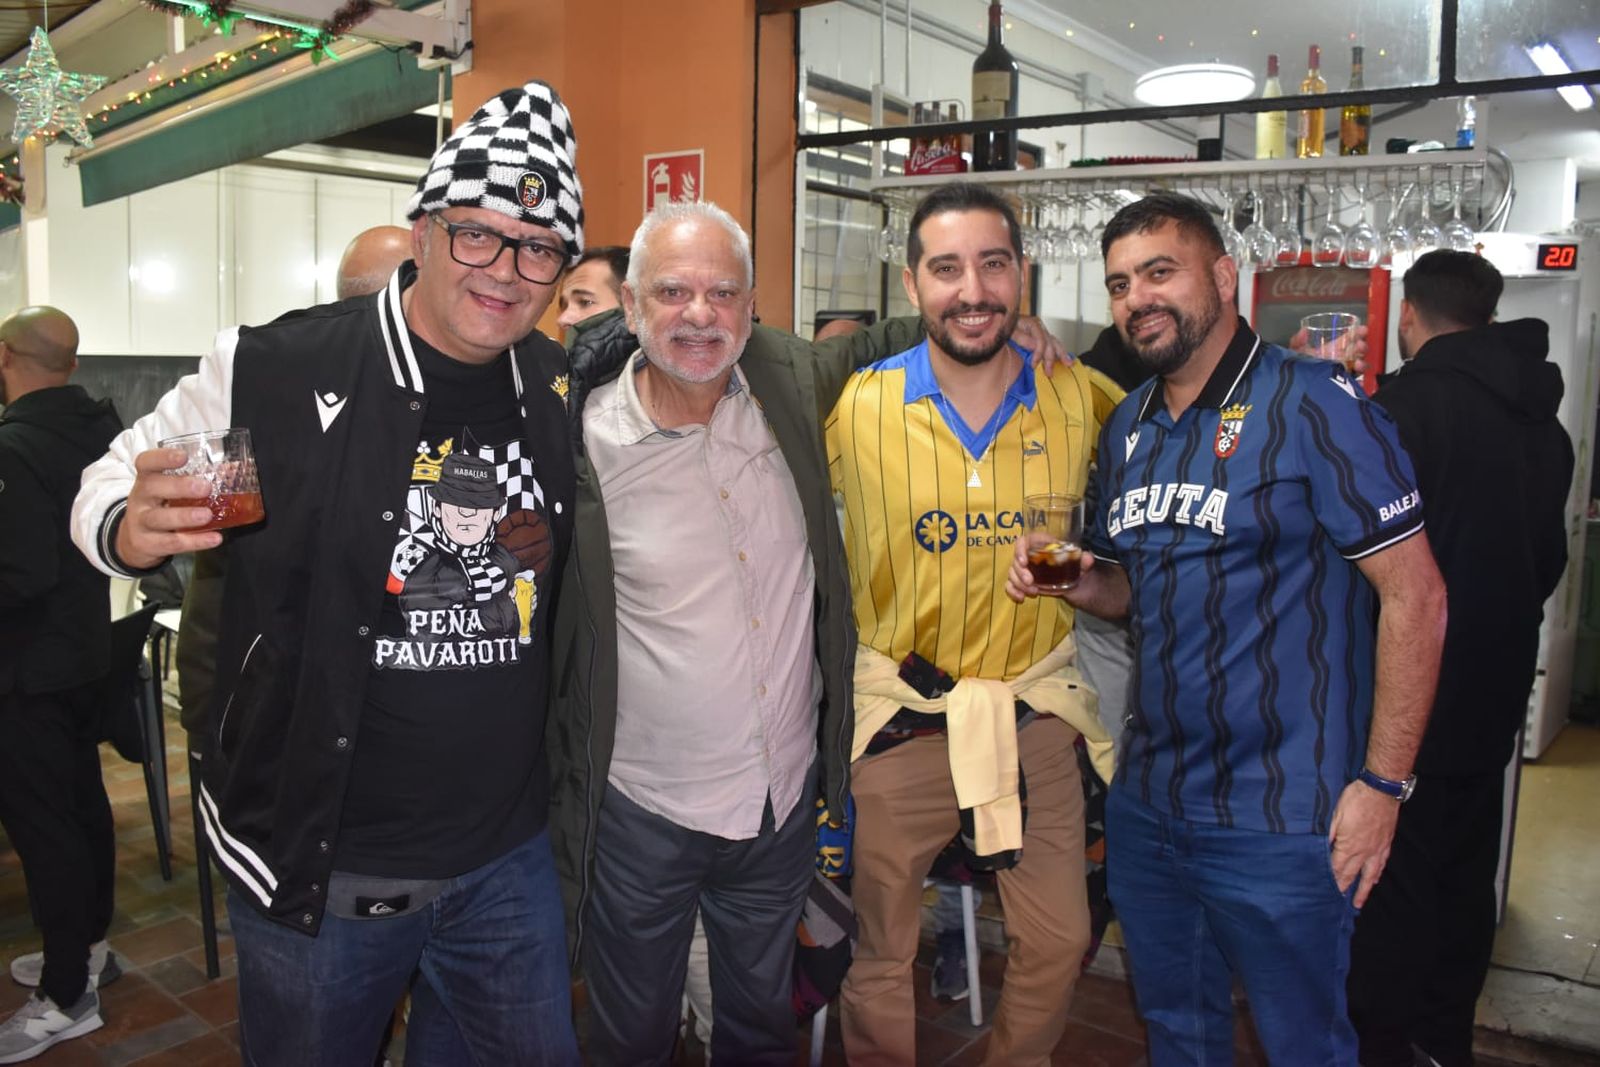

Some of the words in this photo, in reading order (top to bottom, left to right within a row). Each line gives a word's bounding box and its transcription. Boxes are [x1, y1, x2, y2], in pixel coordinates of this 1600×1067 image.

[1271, 270, 1348, 298] Coca-Cola
[966, 512, 991, 530] LA
[1107, 482, 1229, 538] CEUTA
[967, 536, 983, 547] DE
[985, 535, 1018, 547] CANA
[409, 604, 486, 637] PEÑA
[375, 637, 518, 668] PAVAROTI
